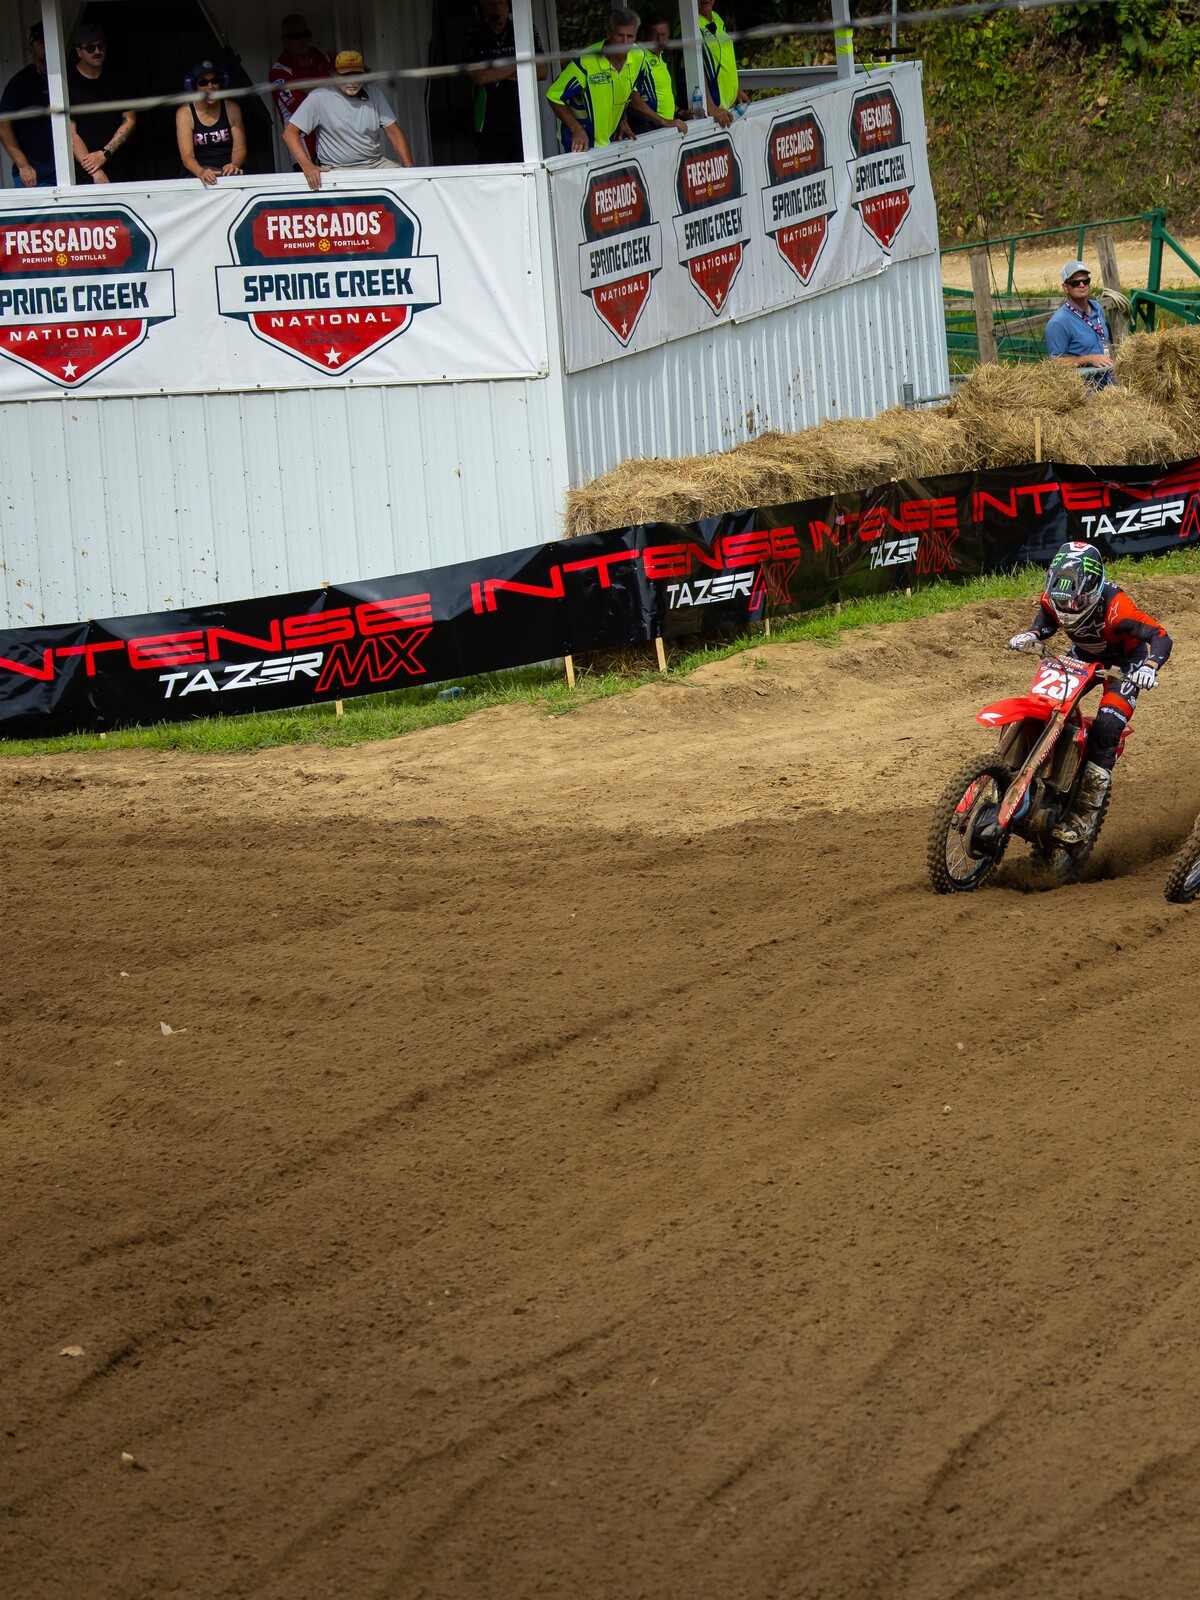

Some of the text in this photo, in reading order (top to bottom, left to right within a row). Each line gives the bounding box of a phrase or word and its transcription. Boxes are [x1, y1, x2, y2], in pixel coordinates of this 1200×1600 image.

[193, 128, 230, 146] RIDE
[776, 127, 814, 162] FRESCADOS
[686, 155, 729, 188] FRESCADOS
[595, 181, 637, 216] FRESCADOS
[772, 179, 828, 222] SPRING CREEK
[266, 211, 381, 240] FRESCADOS
[684, 206, 743, 251] SPRING CREEK
[783, 221, 822, 244] NATIONAL
[5, 226, 118, 256] FRESCADOS
[333, 239, 370, 247] TORTILLAS
[22, 253, 106, 264] PREMIUM TORTILLAS
[590, 234, 651, 279] SPRING CREEK
[695, 251, 738, 273] NATIONAL
[0, 281, 149, 316] PRING CREEK
[243, 267, 414, 303] SPRING CREEK
[600, 280, 645, 303] NATIONAL
[9, 325, 128, 342] NATIONAL
[271, 312, 392, 328] NATIONAL
[308, 328, 355, 337] MILLVILLE
[41, 349, 97, 359] MINNESOTA
[303, 336, 362, 345] MINNESOTA
[809, 496, 959, 552] INTENSE
[471, 526, 800, 614] INTENSE
[0, 592, 434, 681] NTENSE
[1031, 669, 1080, 701] 23
